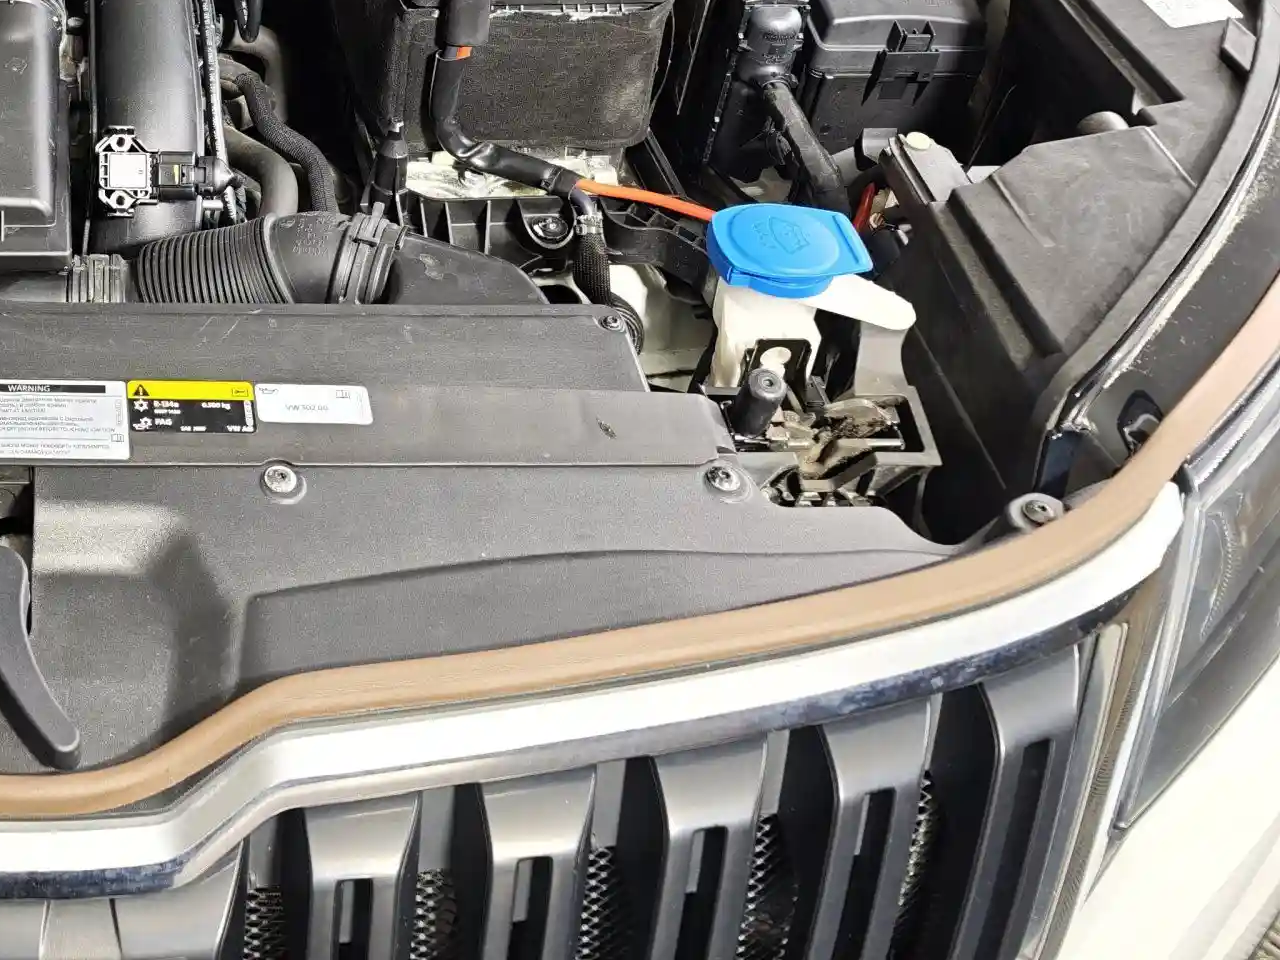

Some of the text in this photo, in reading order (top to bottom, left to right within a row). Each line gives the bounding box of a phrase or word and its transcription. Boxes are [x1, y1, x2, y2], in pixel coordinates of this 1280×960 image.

[7, 384, 51, 393] WARNING
[285, 403, 300, 411] VW
[154, 418, 173, 426] PAG
